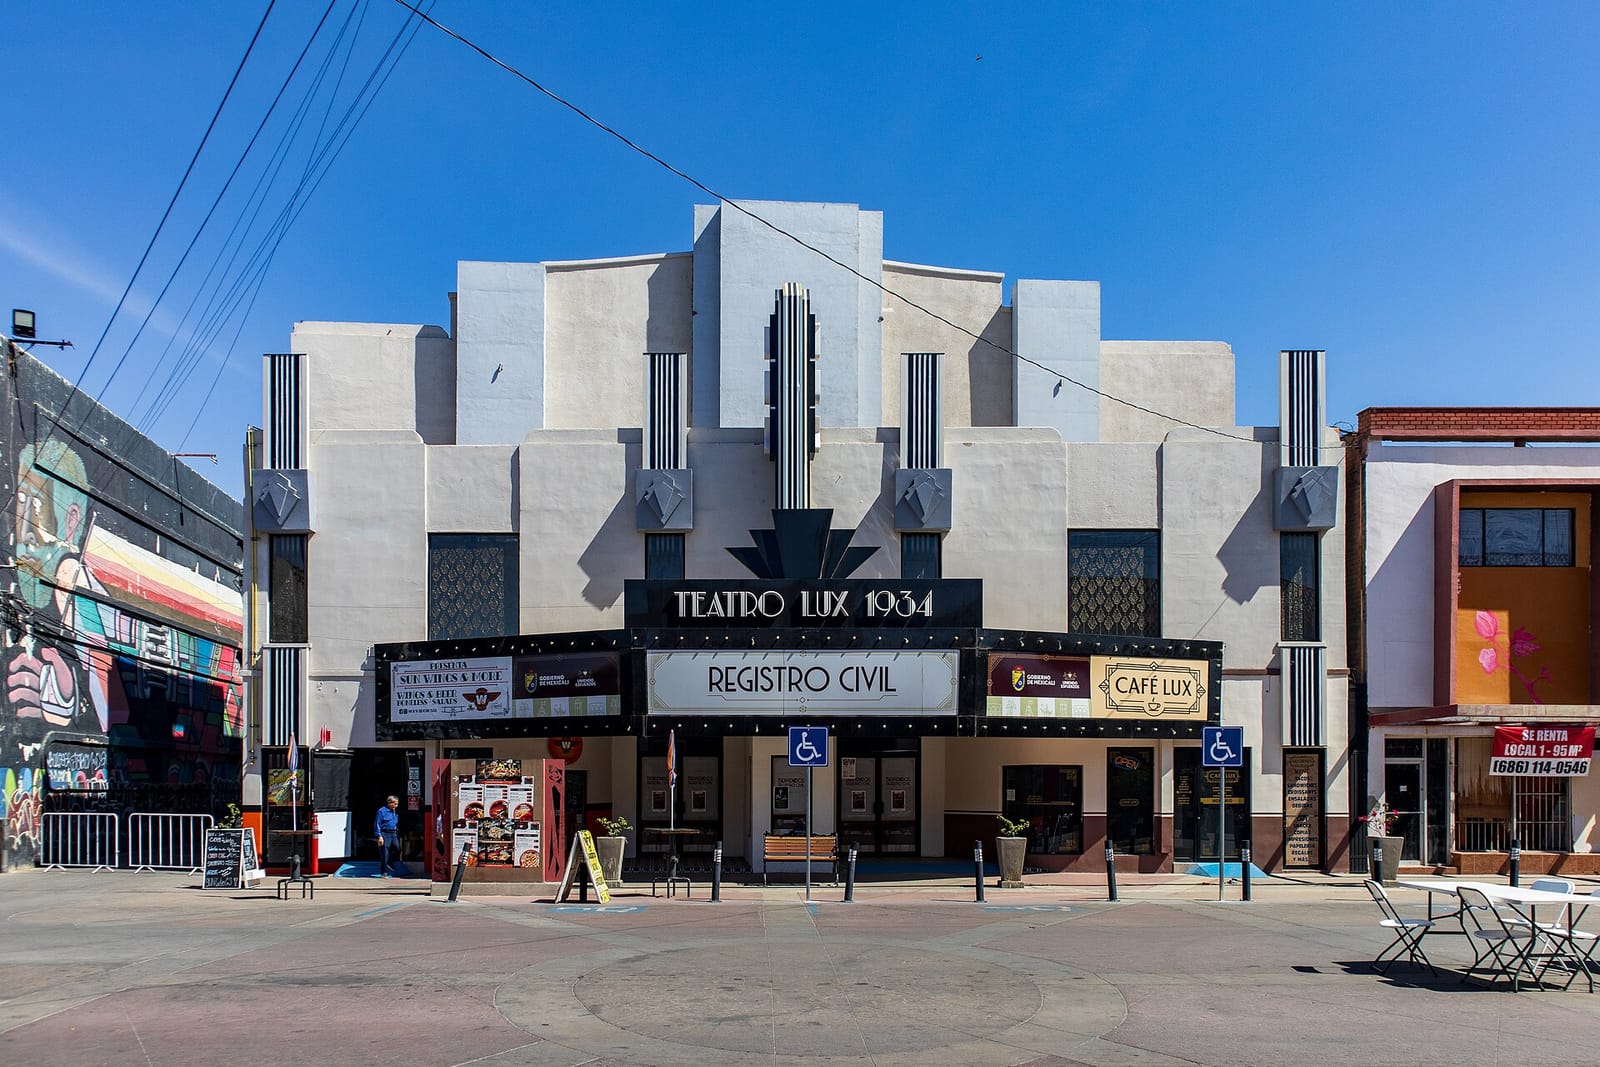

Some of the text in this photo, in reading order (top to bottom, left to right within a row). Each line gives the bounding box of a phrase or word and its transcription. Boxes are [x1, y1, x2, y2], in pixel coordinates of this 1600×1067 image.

[674, 590, 933, 618] TEATRO LUX 1934
[400, 671, 503, 685] SUN WINGS & MORE
[709, 666, 897, 693] REGISTRO CIVIL
[1115, 674, 1192, 696] CAFÉ LUX
[397, 690, 425, 700] WINGS
[436, 689, 458, 698] BEER
[1522, 729, 1568, 741] SE RENTA
[1504, 744, 1537, 757] LOCAL
[1539, 745, 1545, 757] 1
[1553, 744, 1568, 757] 95
[1114, 755, 1139, 770] OPEN
[1493, 760, 1588, 774] (686) 114-0546
